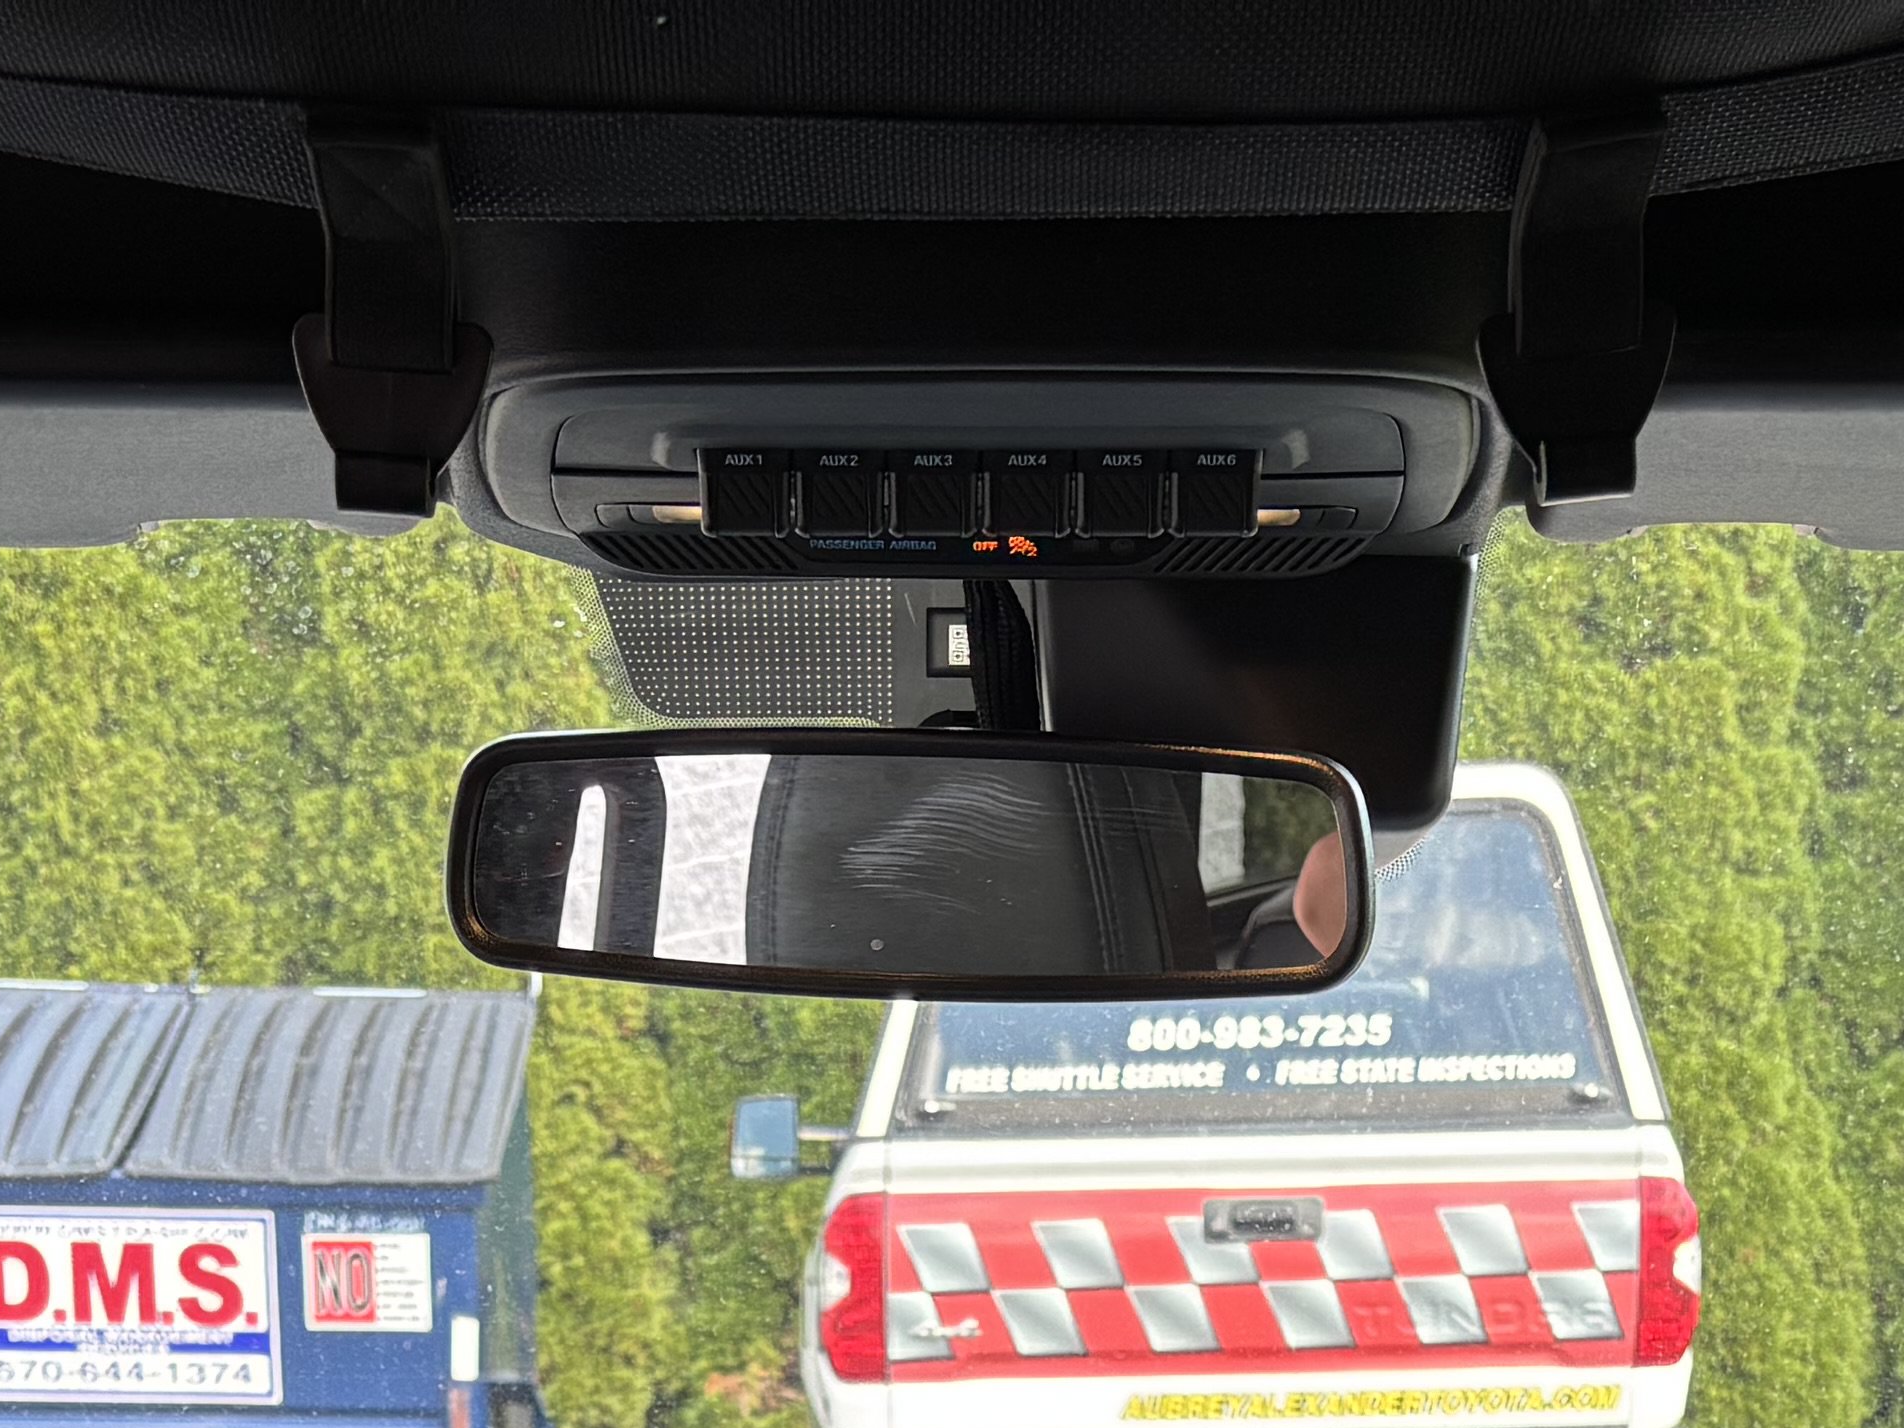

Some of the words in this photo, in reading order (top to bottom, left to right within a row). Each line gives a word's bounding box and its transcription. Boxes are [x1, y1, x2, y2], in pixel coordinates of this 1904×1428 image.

[809, 540, 884, 550] PASSENGER
[972, 541, 998, 551] OFF
[945, 1066, 1010, 1094] FREE
[1274, 1058, 1340, 1086] FREE
[1339, 1056, 1418, 1084] STATE
[314, 1248, 373, 1315] NO
